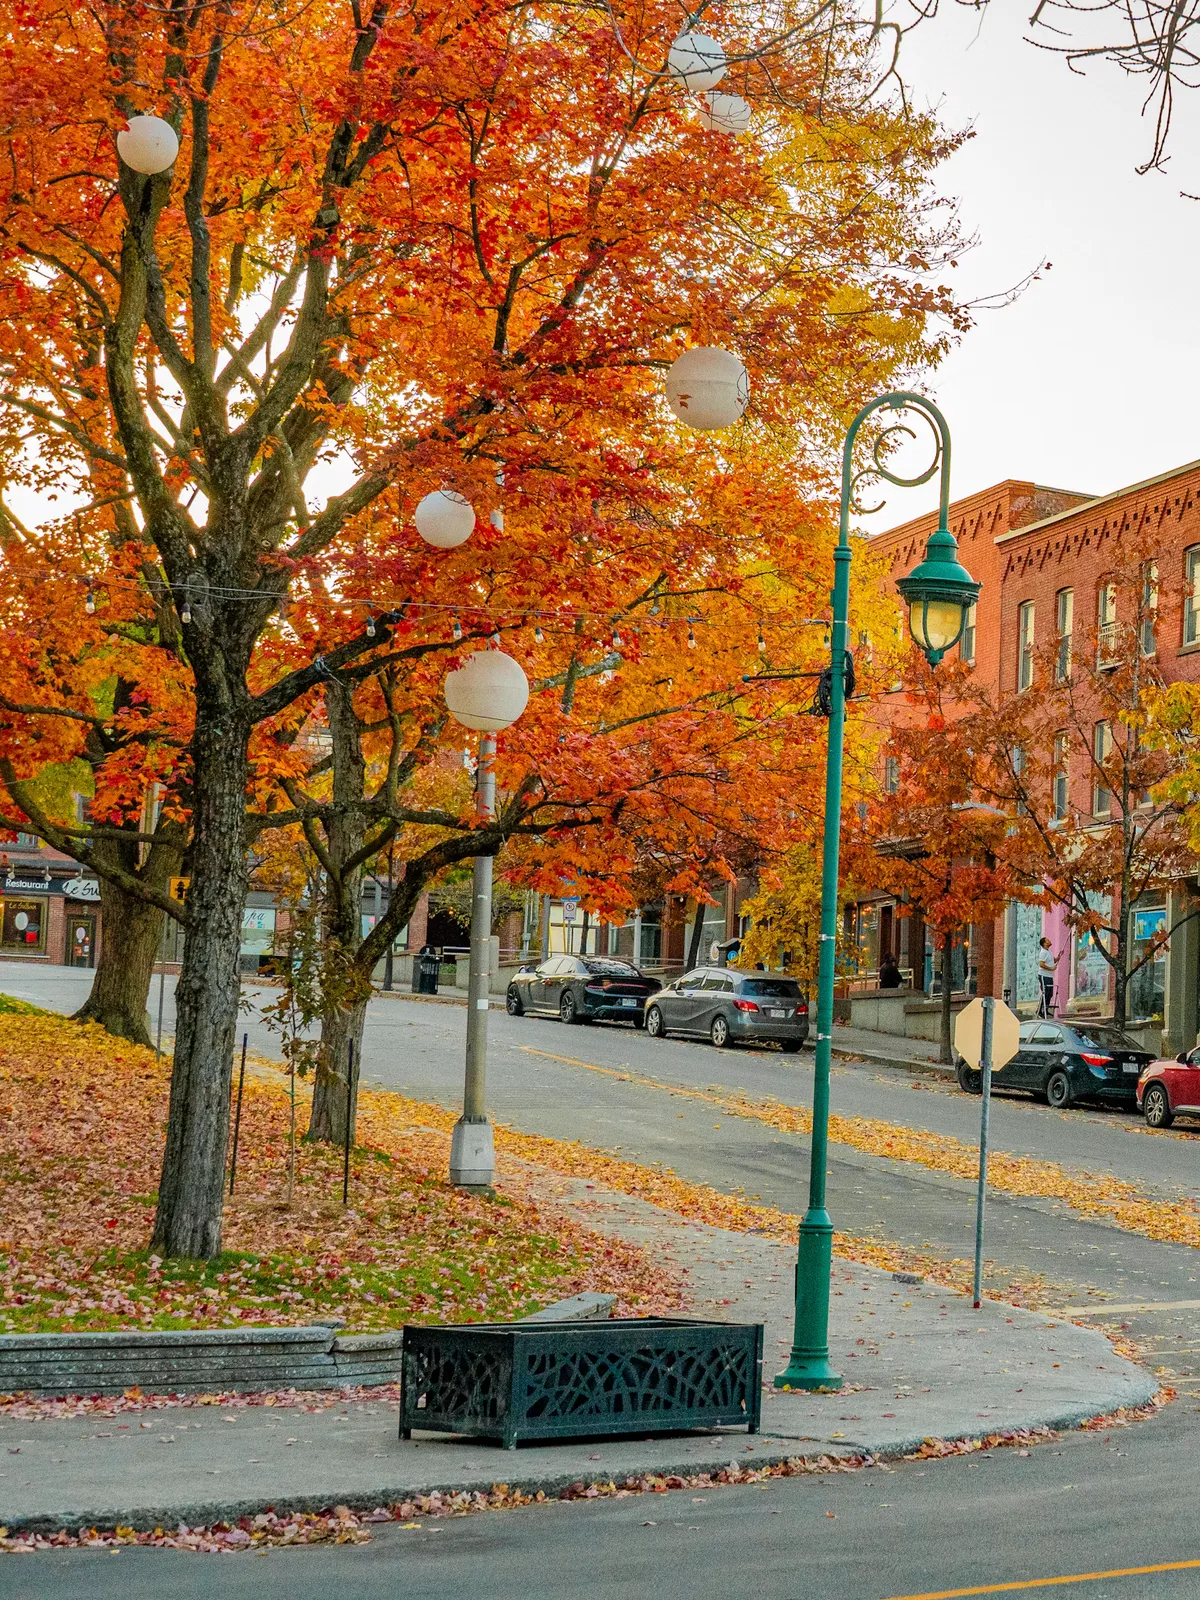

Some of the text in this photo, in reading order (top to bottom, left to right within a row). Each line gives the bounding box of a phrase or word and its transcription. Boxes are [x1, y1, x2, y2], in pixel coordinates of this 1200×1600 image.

[5, 878, 49, 889] Restaurant
[81, 882, 100, 896] Su
[243, 909, 266, 927] pa
